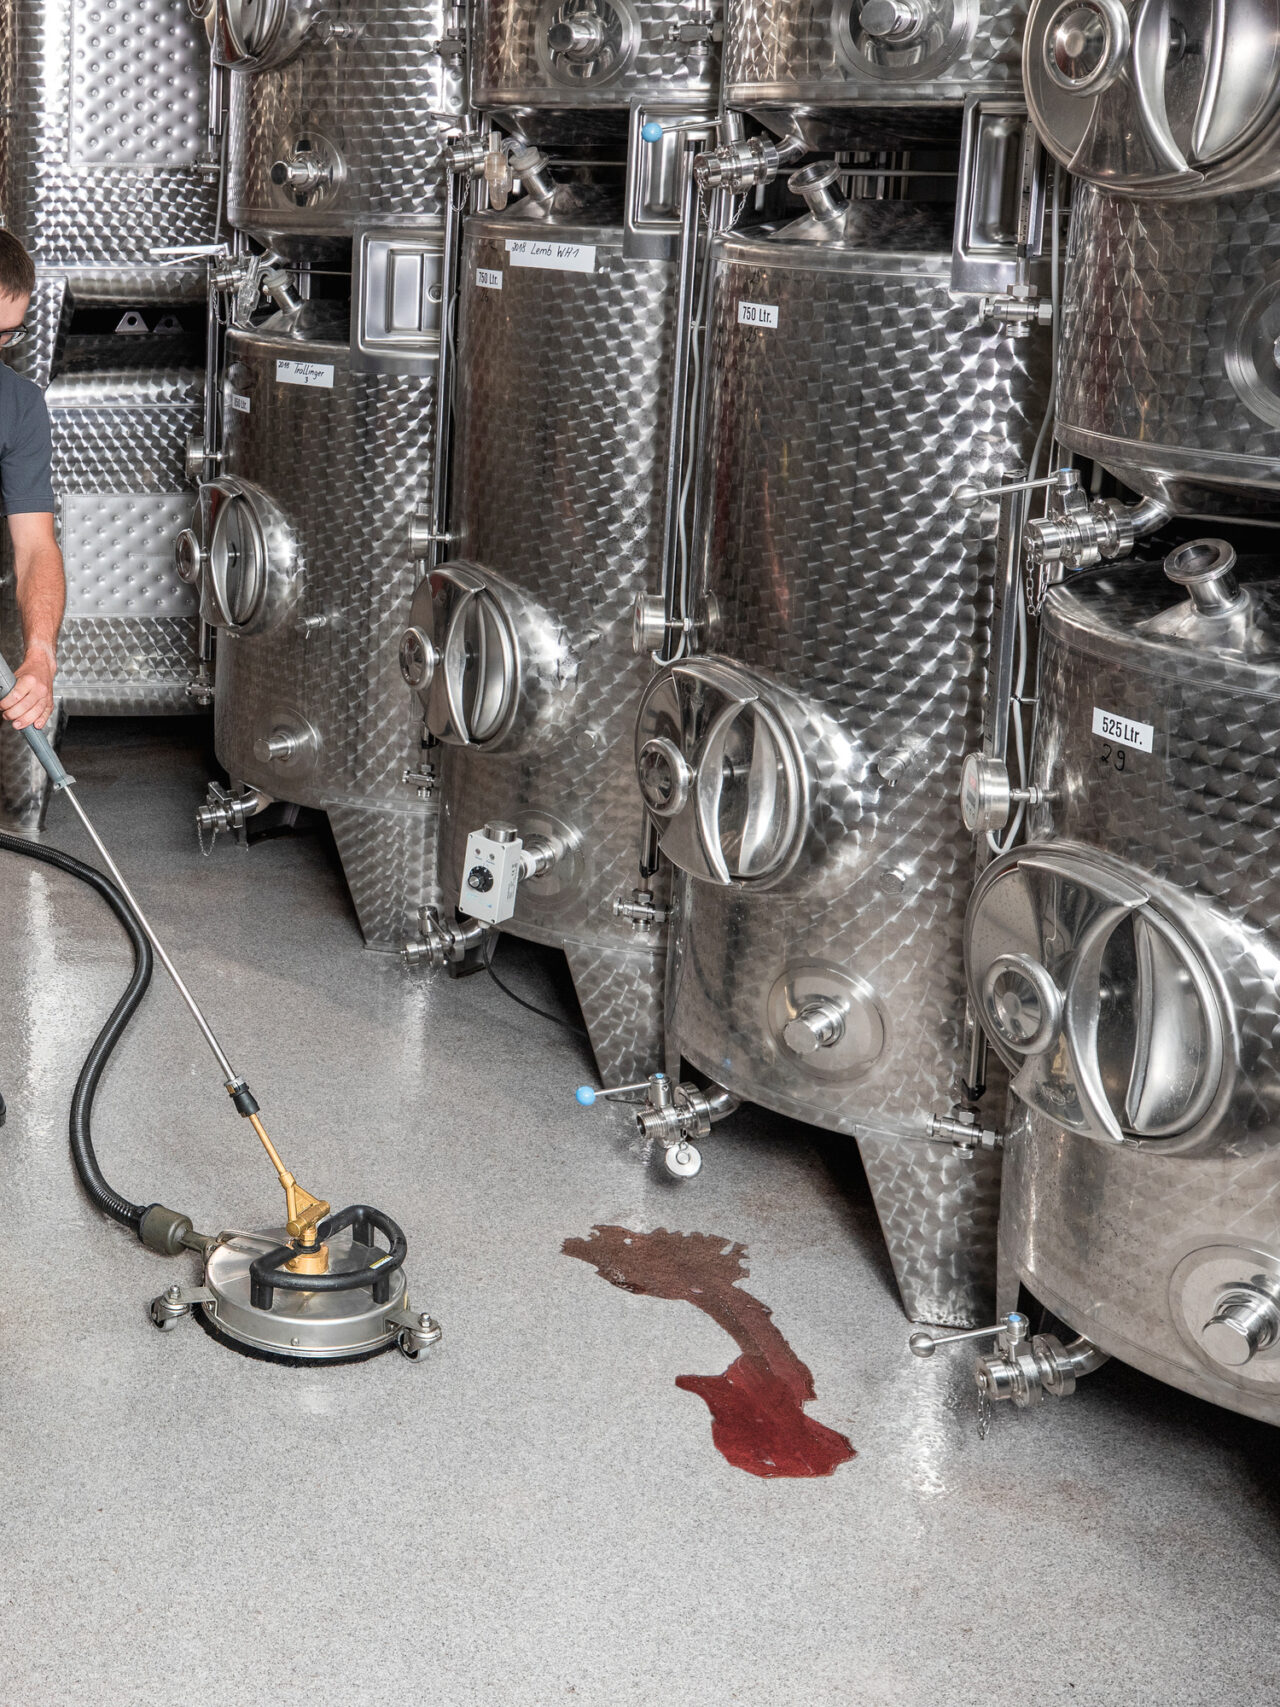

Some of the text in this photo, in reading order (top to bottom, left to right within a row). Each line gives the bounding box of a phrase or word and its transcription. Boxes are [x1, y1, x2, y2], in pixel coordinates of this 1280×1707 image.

[511, 242, 526, 252] 2018
[531, 243, 552, 255] Lemb
[478, 271, 499, 285] 750 Ltr.
[742, 306, 772, 323] 750 Ltr.
[293, 362, 325, 380] Trollinger
[1102, 716, 1142, 745] 525 Ltr.
[1101, 743, 1125, 771] 29
